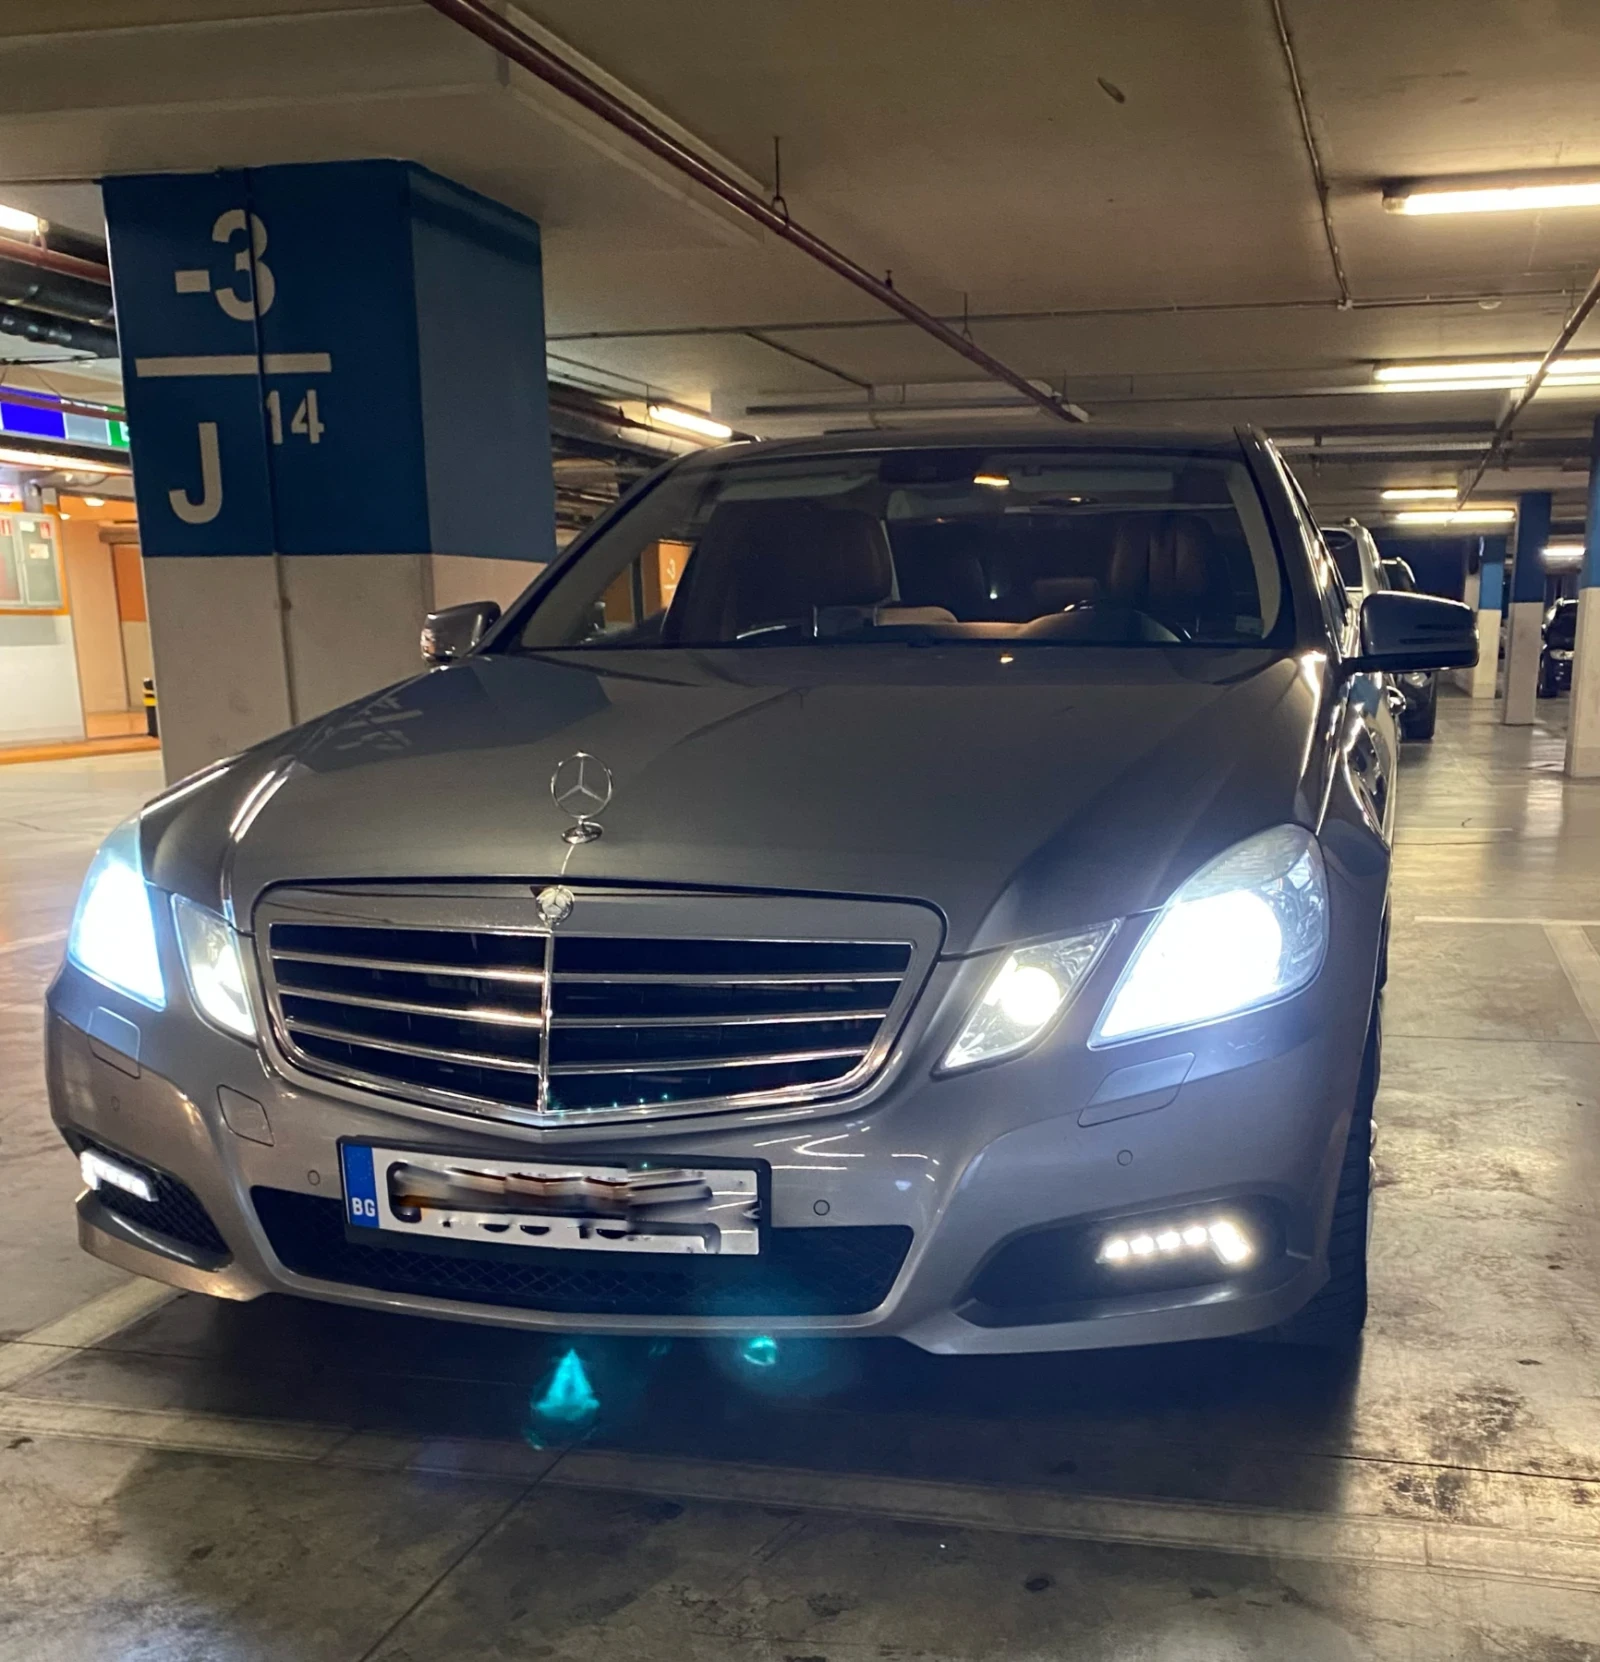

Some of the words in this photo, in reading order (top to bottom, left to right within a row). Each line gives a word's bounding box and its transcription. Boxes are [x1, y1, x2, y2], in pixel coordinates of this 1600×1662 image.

[175, 209, 275, 321] -3
[169, 422, 222, 524] J
[266, 389, 325, 444] 14
[352, 1197, 375, 1217] BG
